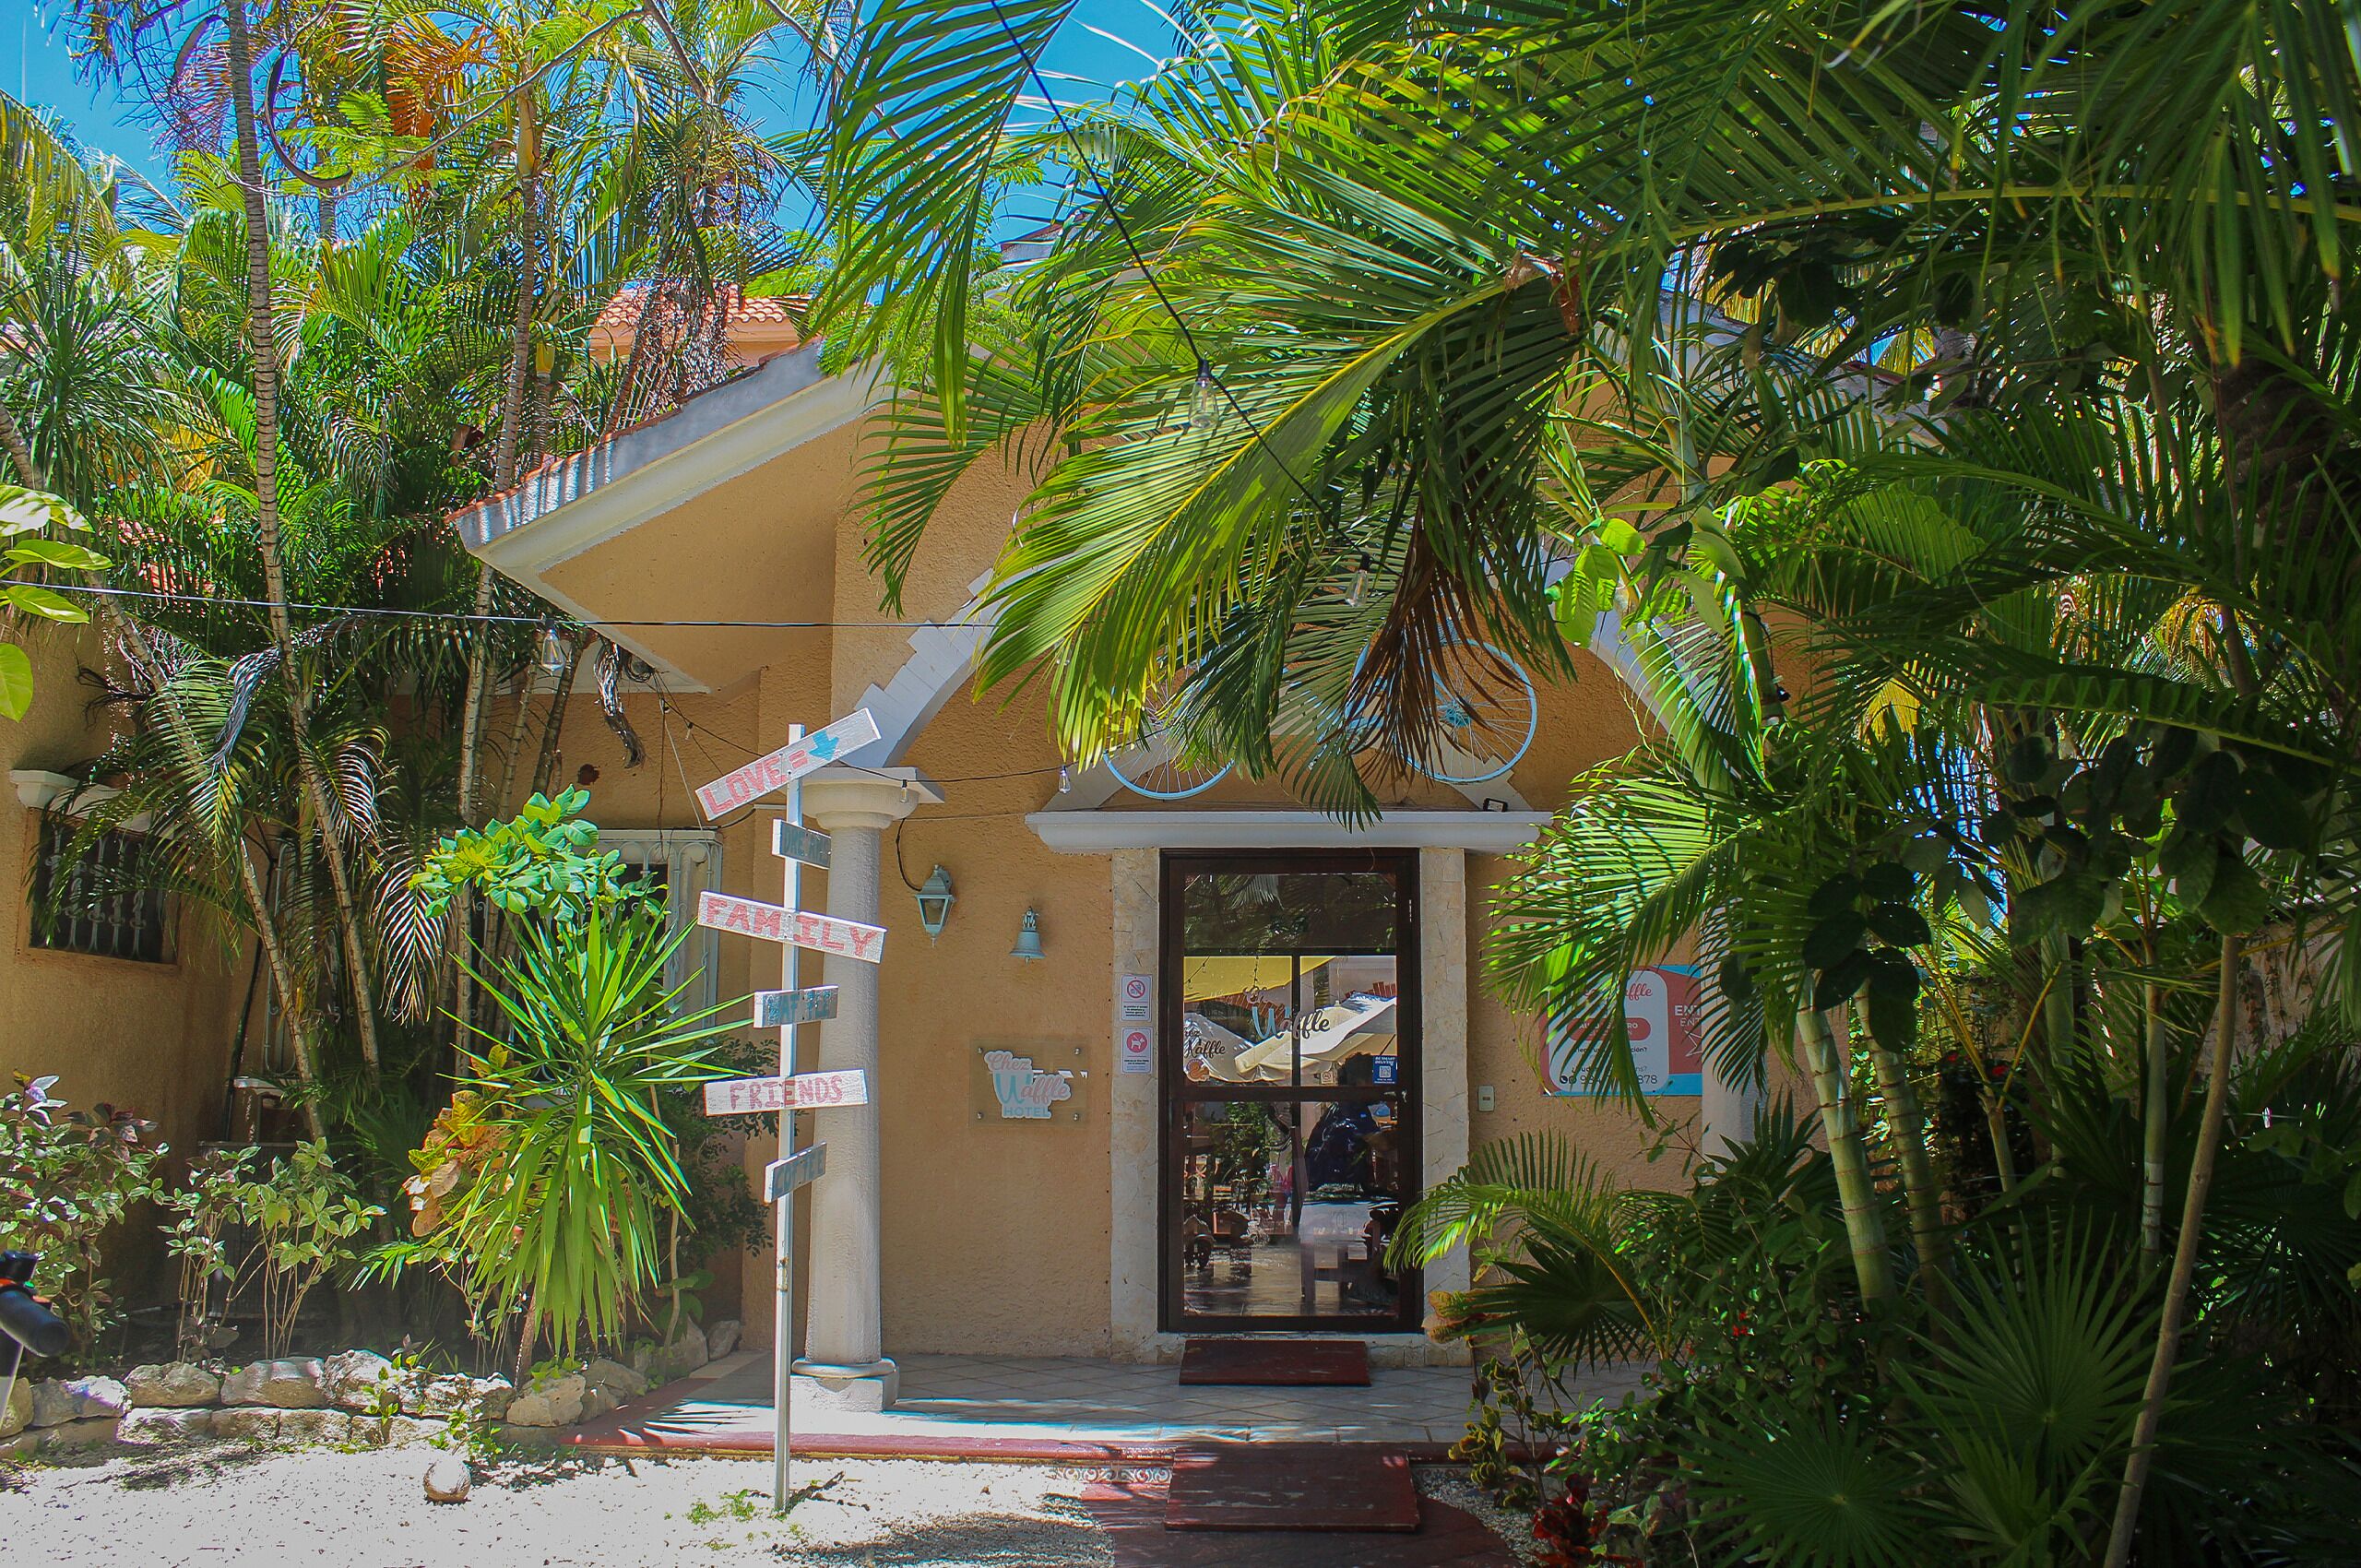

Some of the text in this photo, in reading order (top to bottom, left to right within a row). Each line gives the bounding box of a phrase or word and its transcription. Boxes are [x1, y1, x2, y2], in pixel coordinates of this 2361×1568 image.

[703, 754, 787, 814] LOVE
[706, 897, 877, 956] FAMILY
[1252, 1005, 1330, 1039] Waffle
[988, 1053, 1029, 1071] Chez
[730, 1075, 843, 1110] FRIENDS
[995, 1073, 1067, 1105] Waffle
[1003, 1107, 1050, 1118] HOTEL
